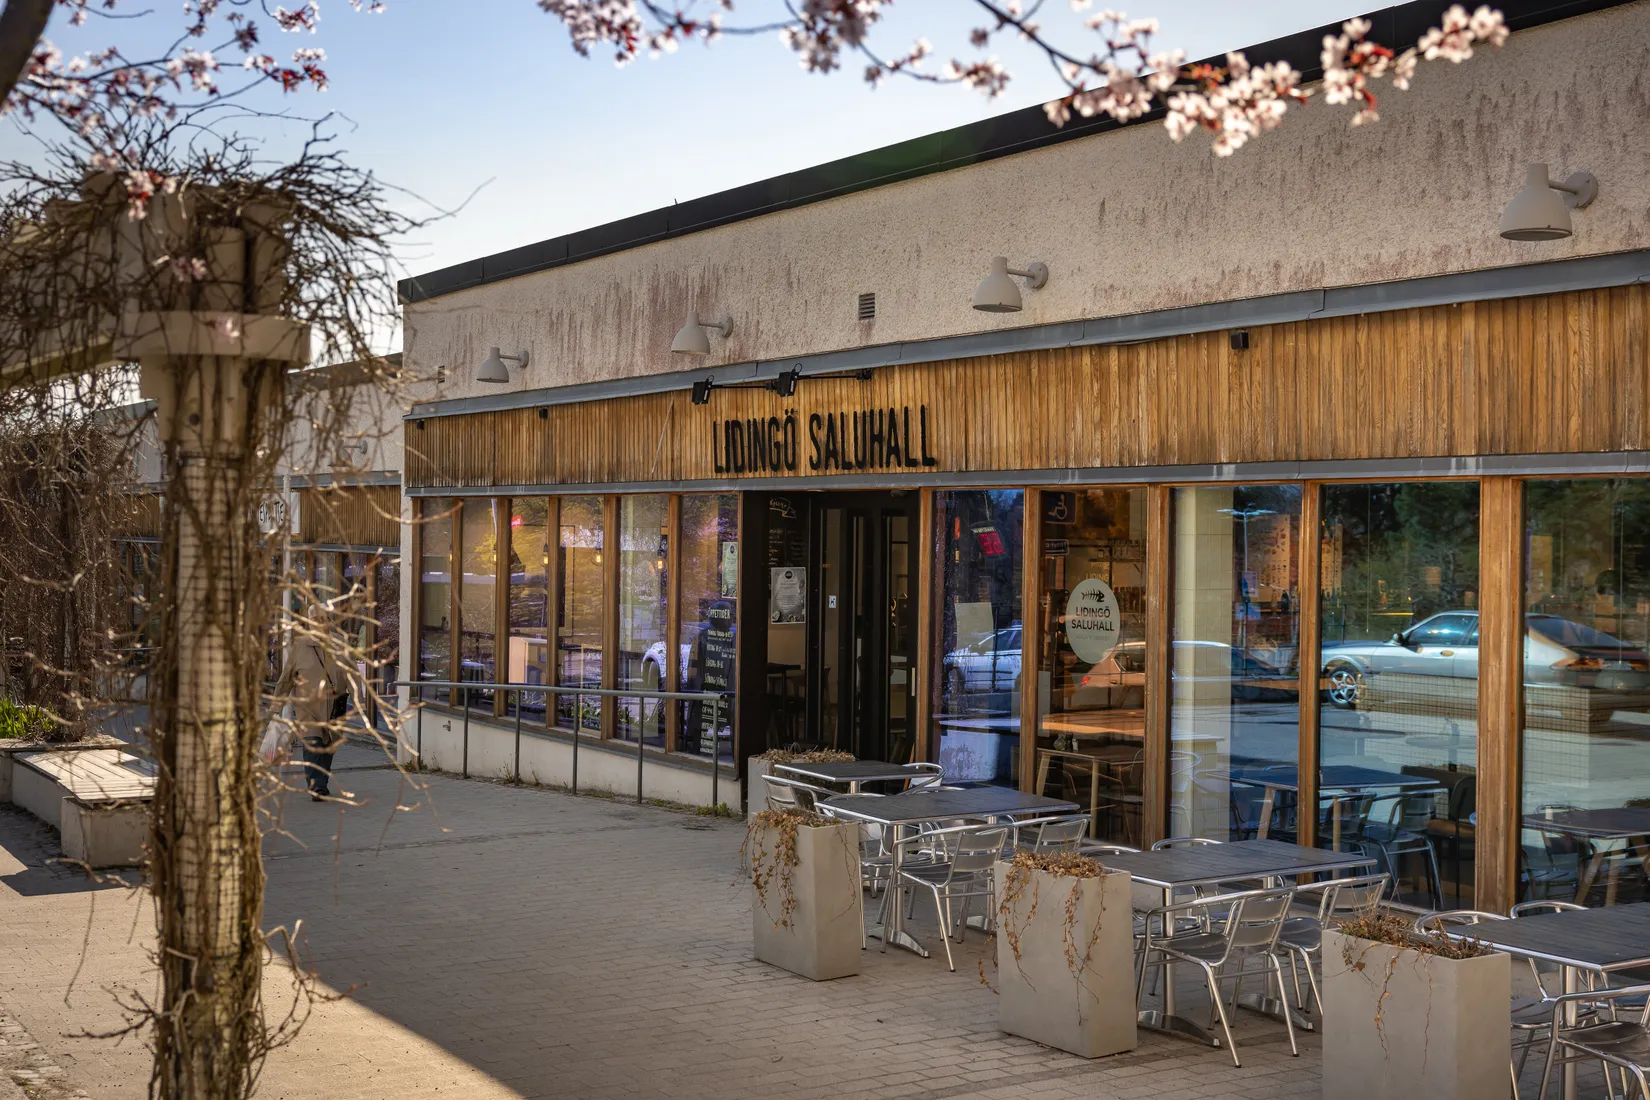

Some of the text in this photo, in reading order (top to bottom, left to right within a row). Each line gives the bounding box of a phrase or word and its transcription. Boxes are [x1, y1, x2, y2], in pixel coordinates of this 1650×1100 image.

[713, 404, 937, 474] LIDINGÖ SALUHALL
[1075, 606, 1111, 619] LIDINGÖ
[1071, 619, 1115, 632] SALUHALL
